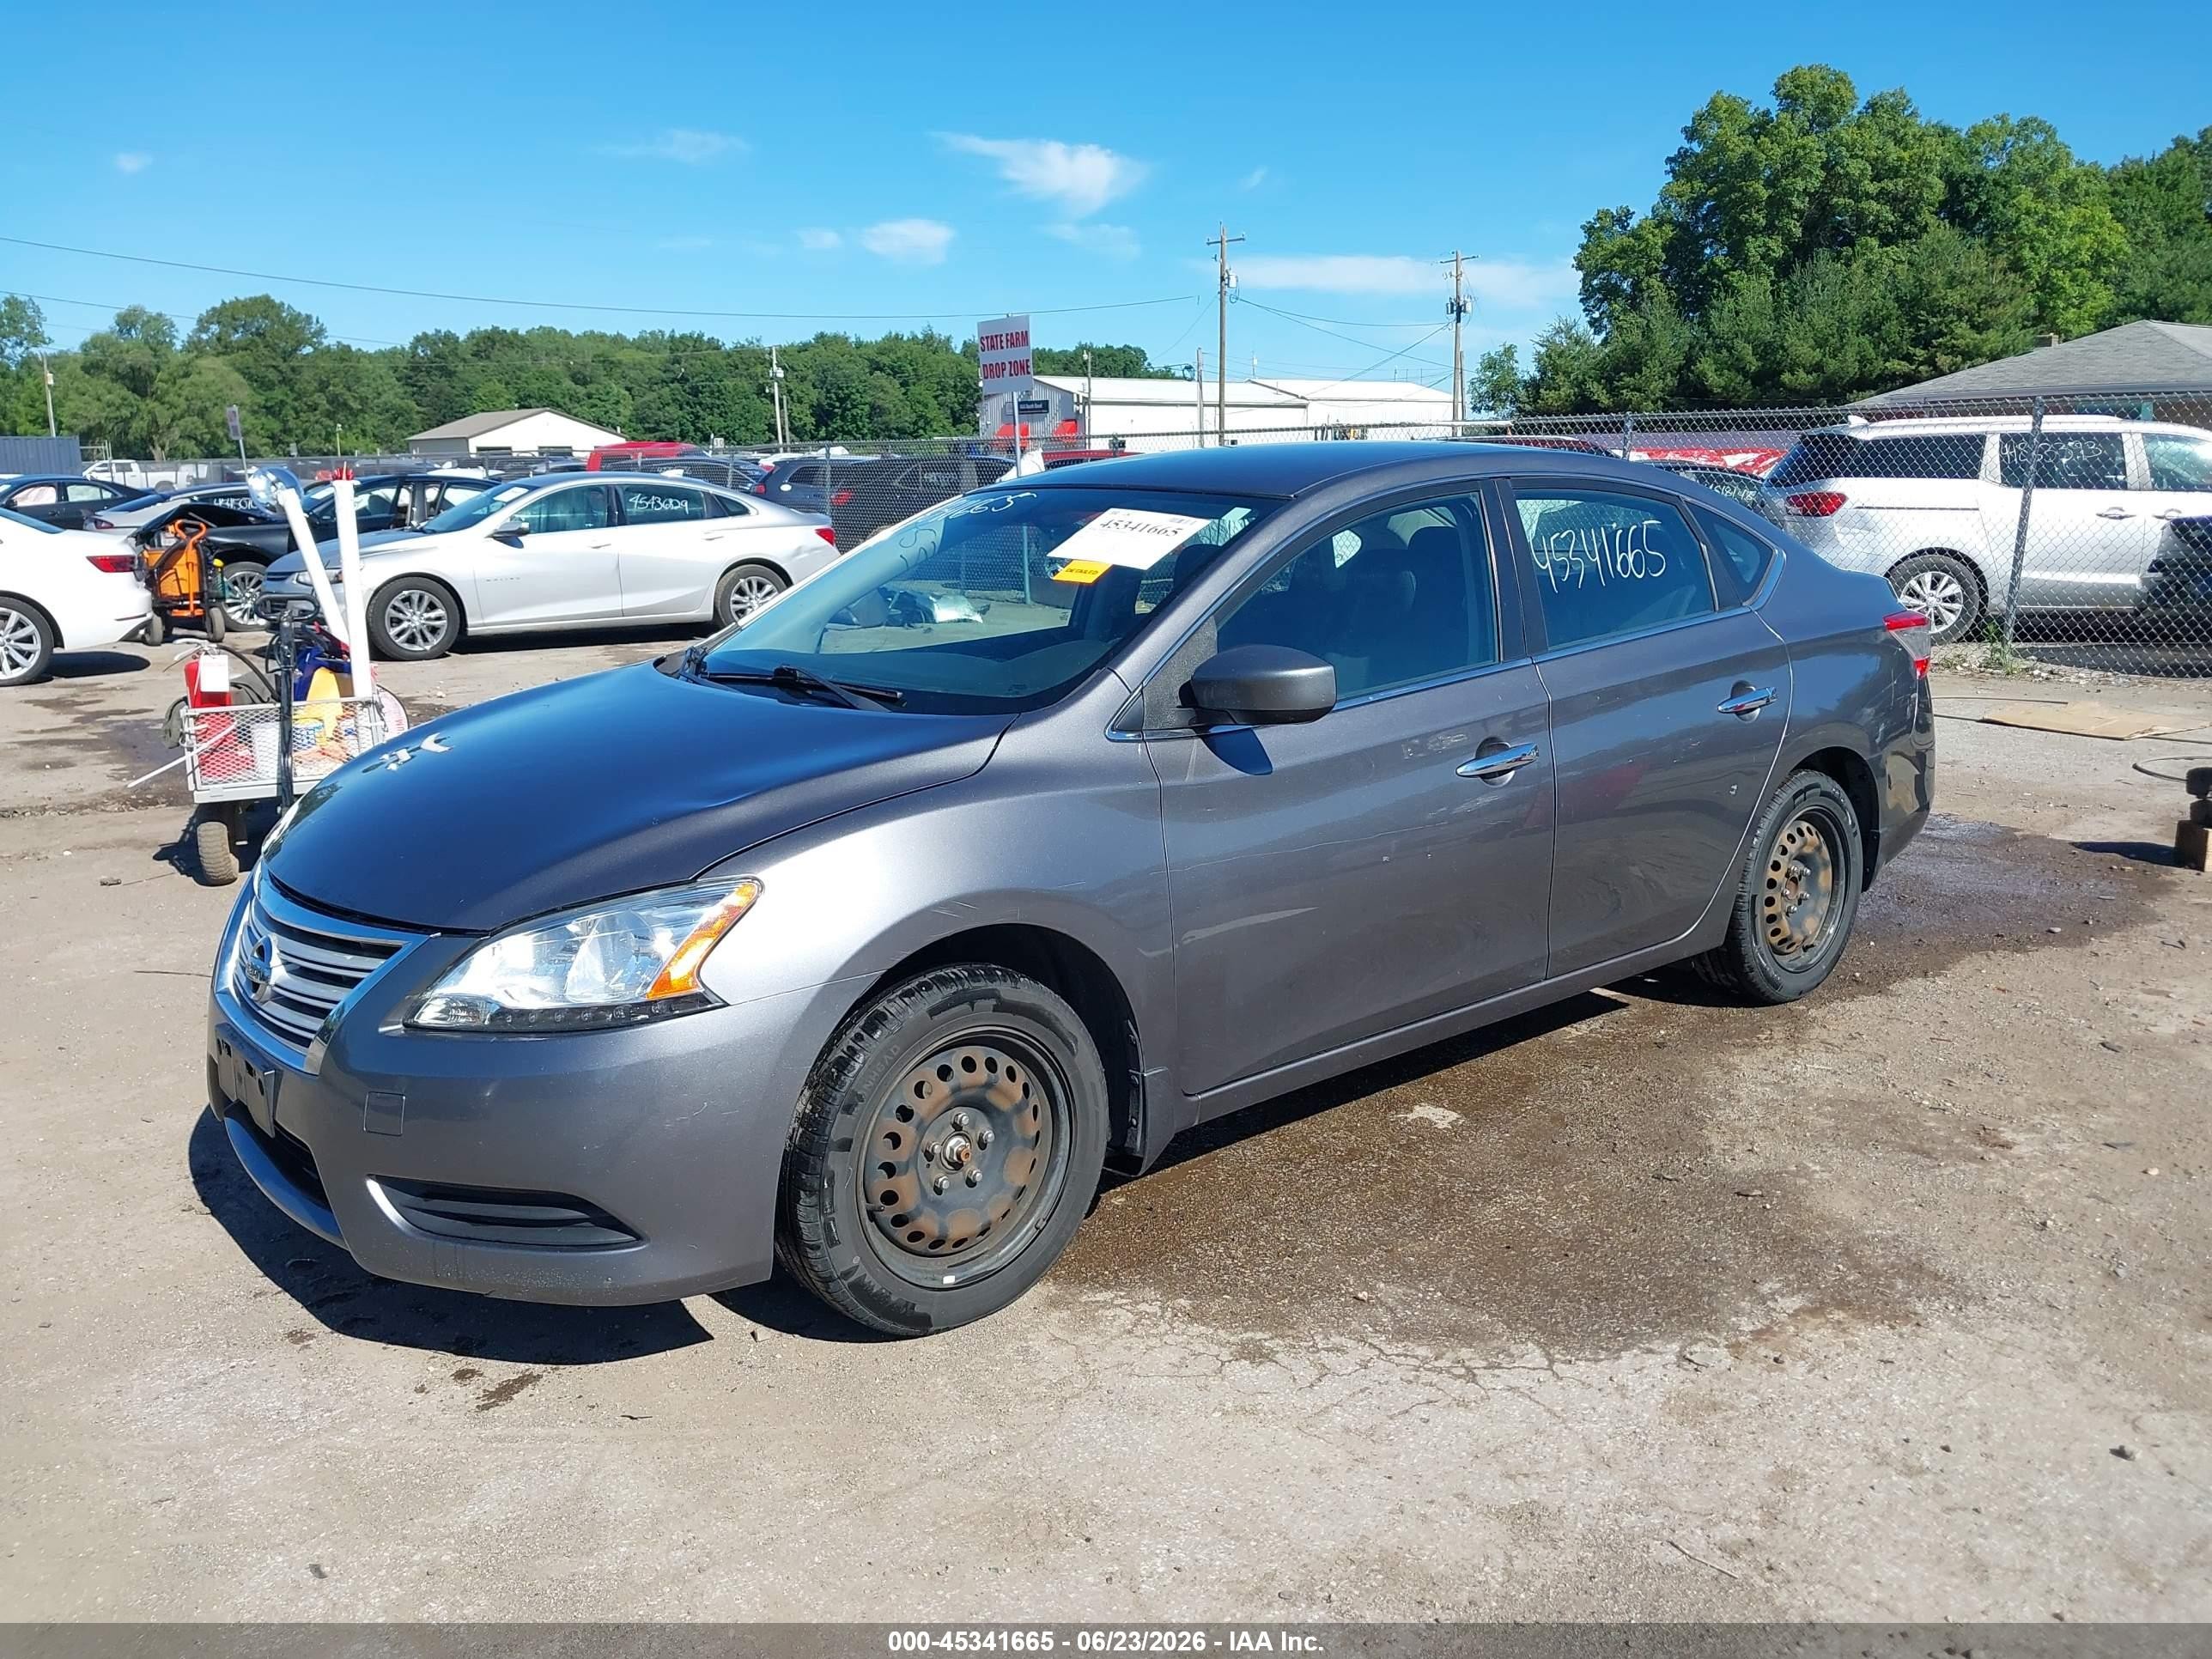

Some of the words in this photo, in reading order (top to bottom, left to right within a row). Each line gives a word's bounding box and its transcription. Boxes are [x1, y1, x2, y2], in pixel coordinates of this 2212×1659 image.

[980, 333, 1004, 353] STATE
[1006, 331, 1029, 349] FARM
[982, 362, 1006, 380] DROP
[1008, 358, 1030, 377] ZONE
[1100, 519, 1183, 538] 45341665
[1529, 520, 1666, 593] 45341665
